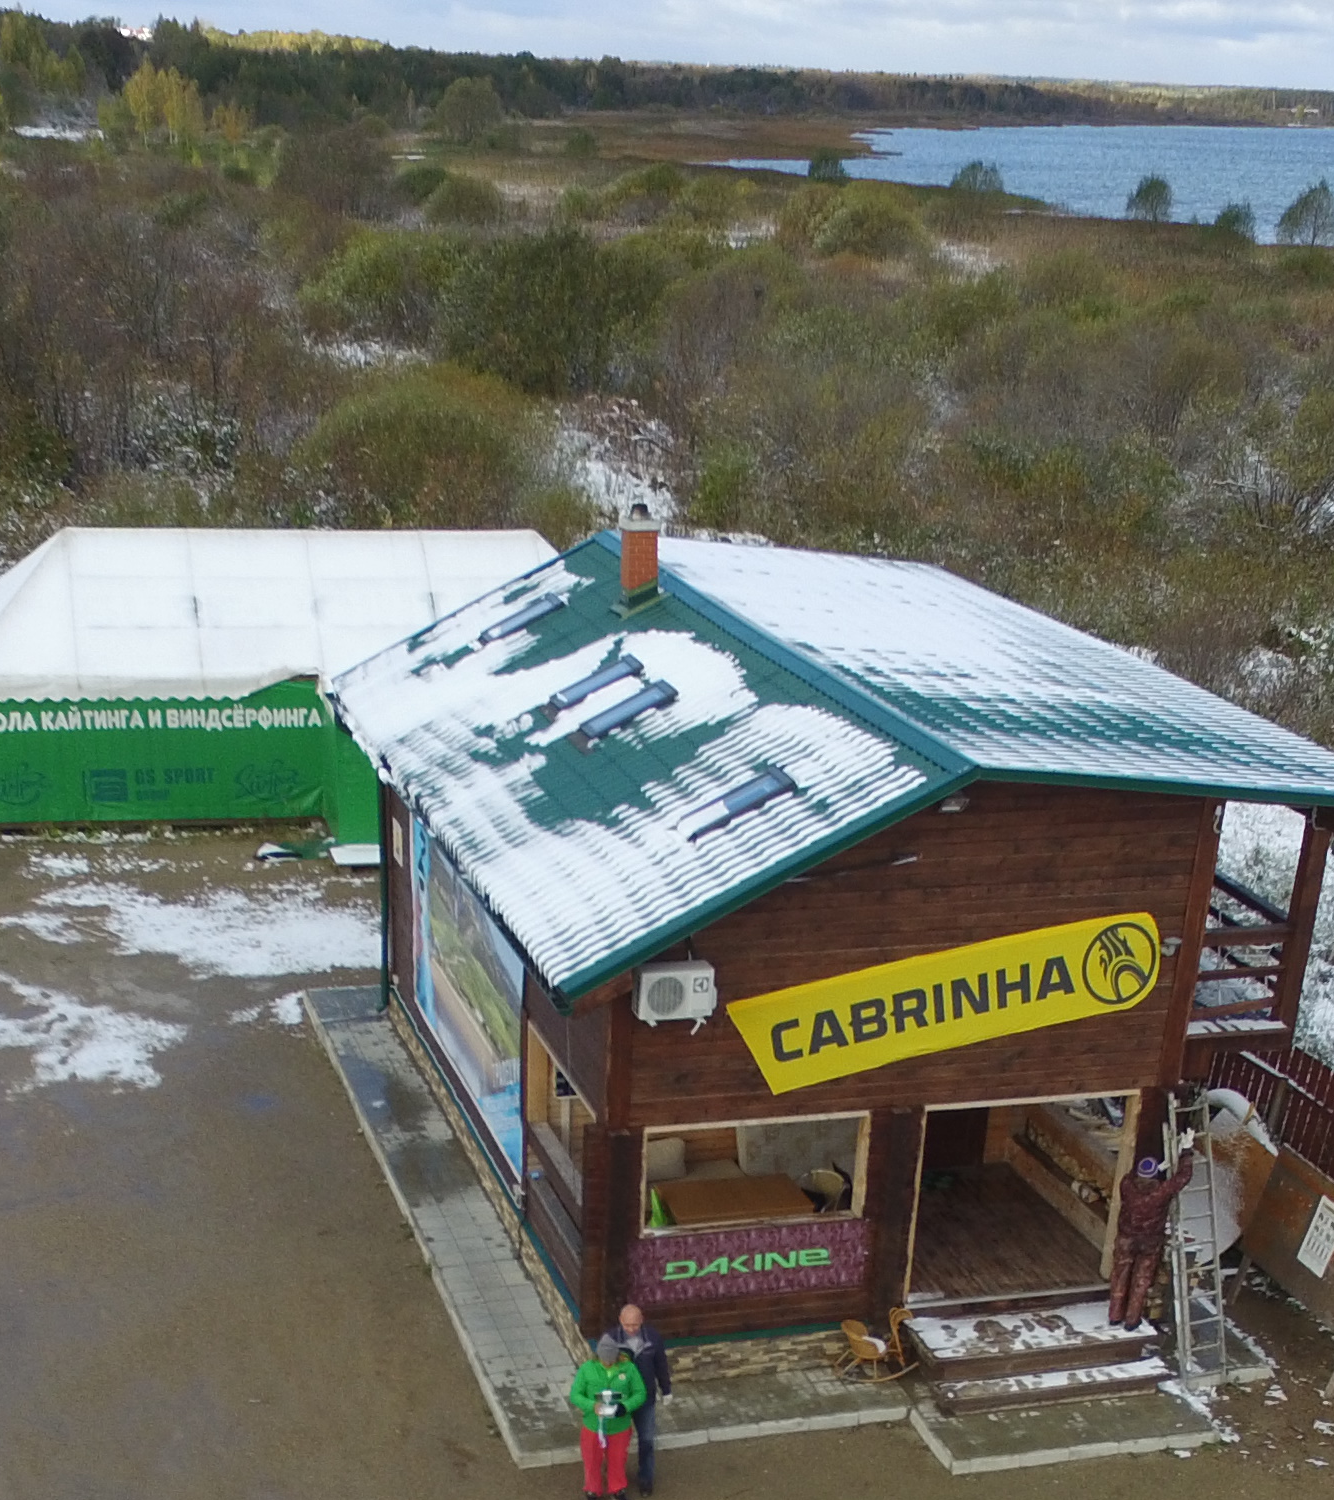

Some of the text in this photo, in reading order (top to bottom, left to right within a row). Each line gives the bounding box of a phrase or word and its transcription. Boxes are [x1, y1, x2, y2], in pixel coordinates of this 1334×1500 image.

[40, 705, 145, 732] КАЙТИНГА
[148, 708, 162, 729] И
[167, 703, 323, 732] ВИНДСЁРФИНГА
[770, 955, 1076, 1064] CABRINHA
[662, 1247, 831, 1281] DAKINE
